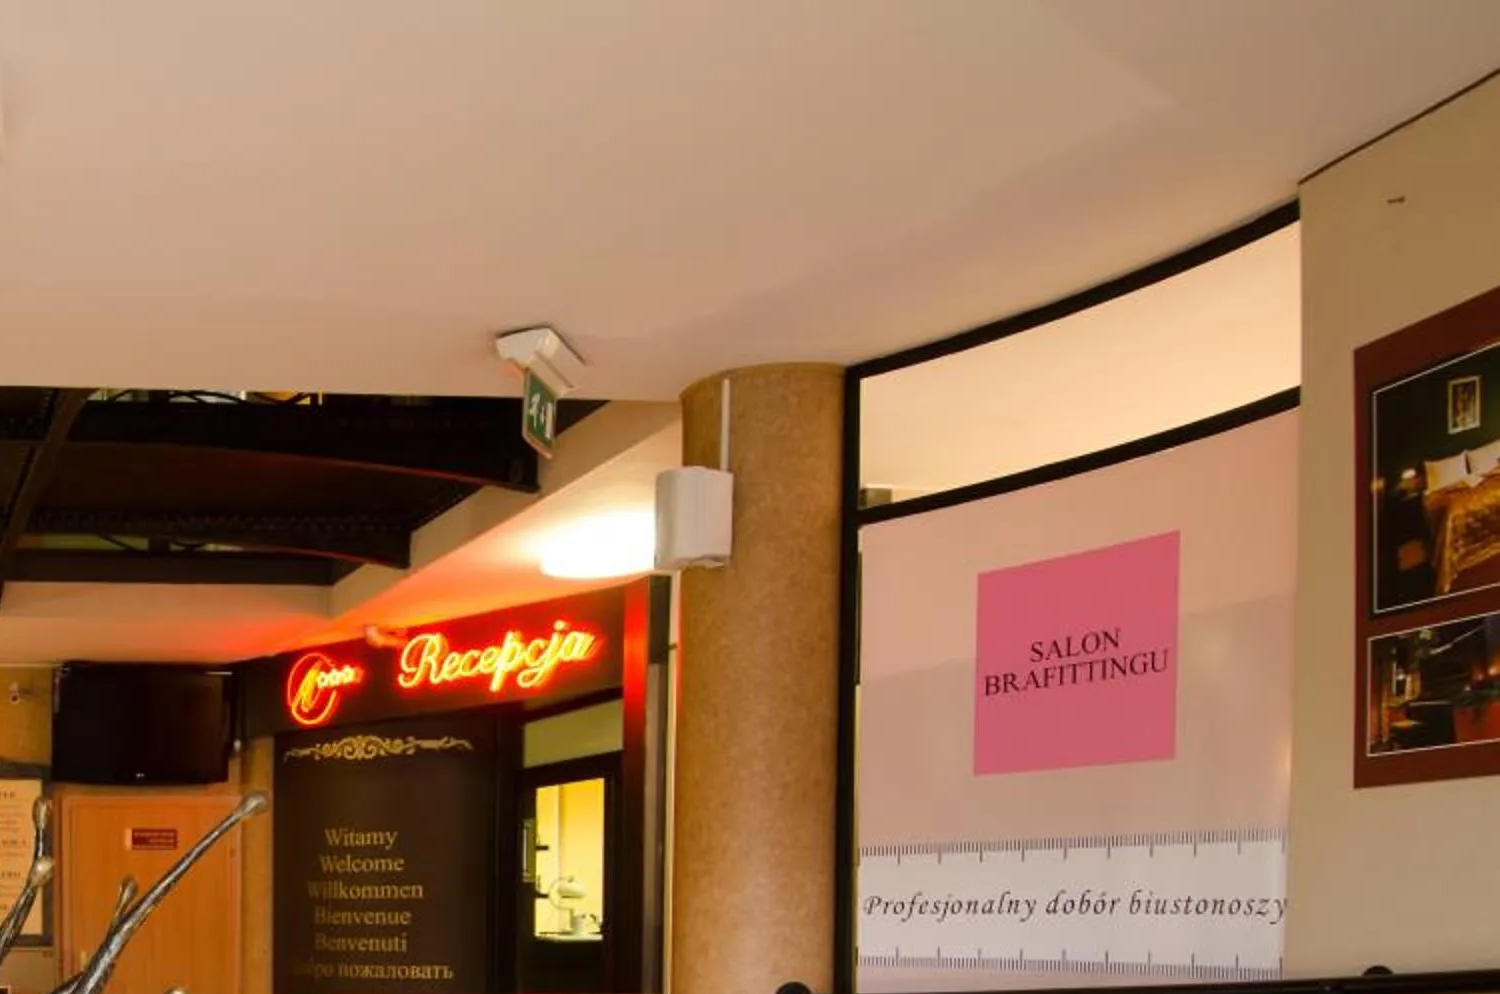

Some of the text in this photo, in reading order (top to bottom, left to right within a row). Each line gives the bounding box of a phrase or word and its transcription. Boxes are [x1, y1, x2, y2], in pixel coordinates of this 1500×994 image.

[1030, 627, 1122, 662] SALON
[398, 620, 595, 692] Recepcja
[984, 648, 1169, 696] BRAFITTINGU
[324, 828, 398, 850] Witamy
[319, 854, 405, 873] Welcome
[308, 880, 424, 899] Willkommen
[314, 905, 412, 925] Bienvenue
[863, 888, 1289, 925] Profesjonalny dobór biustonoszy
[314, 932, 408, 952] Benvenuti
[337, 963, 454, 980] пожаловать
